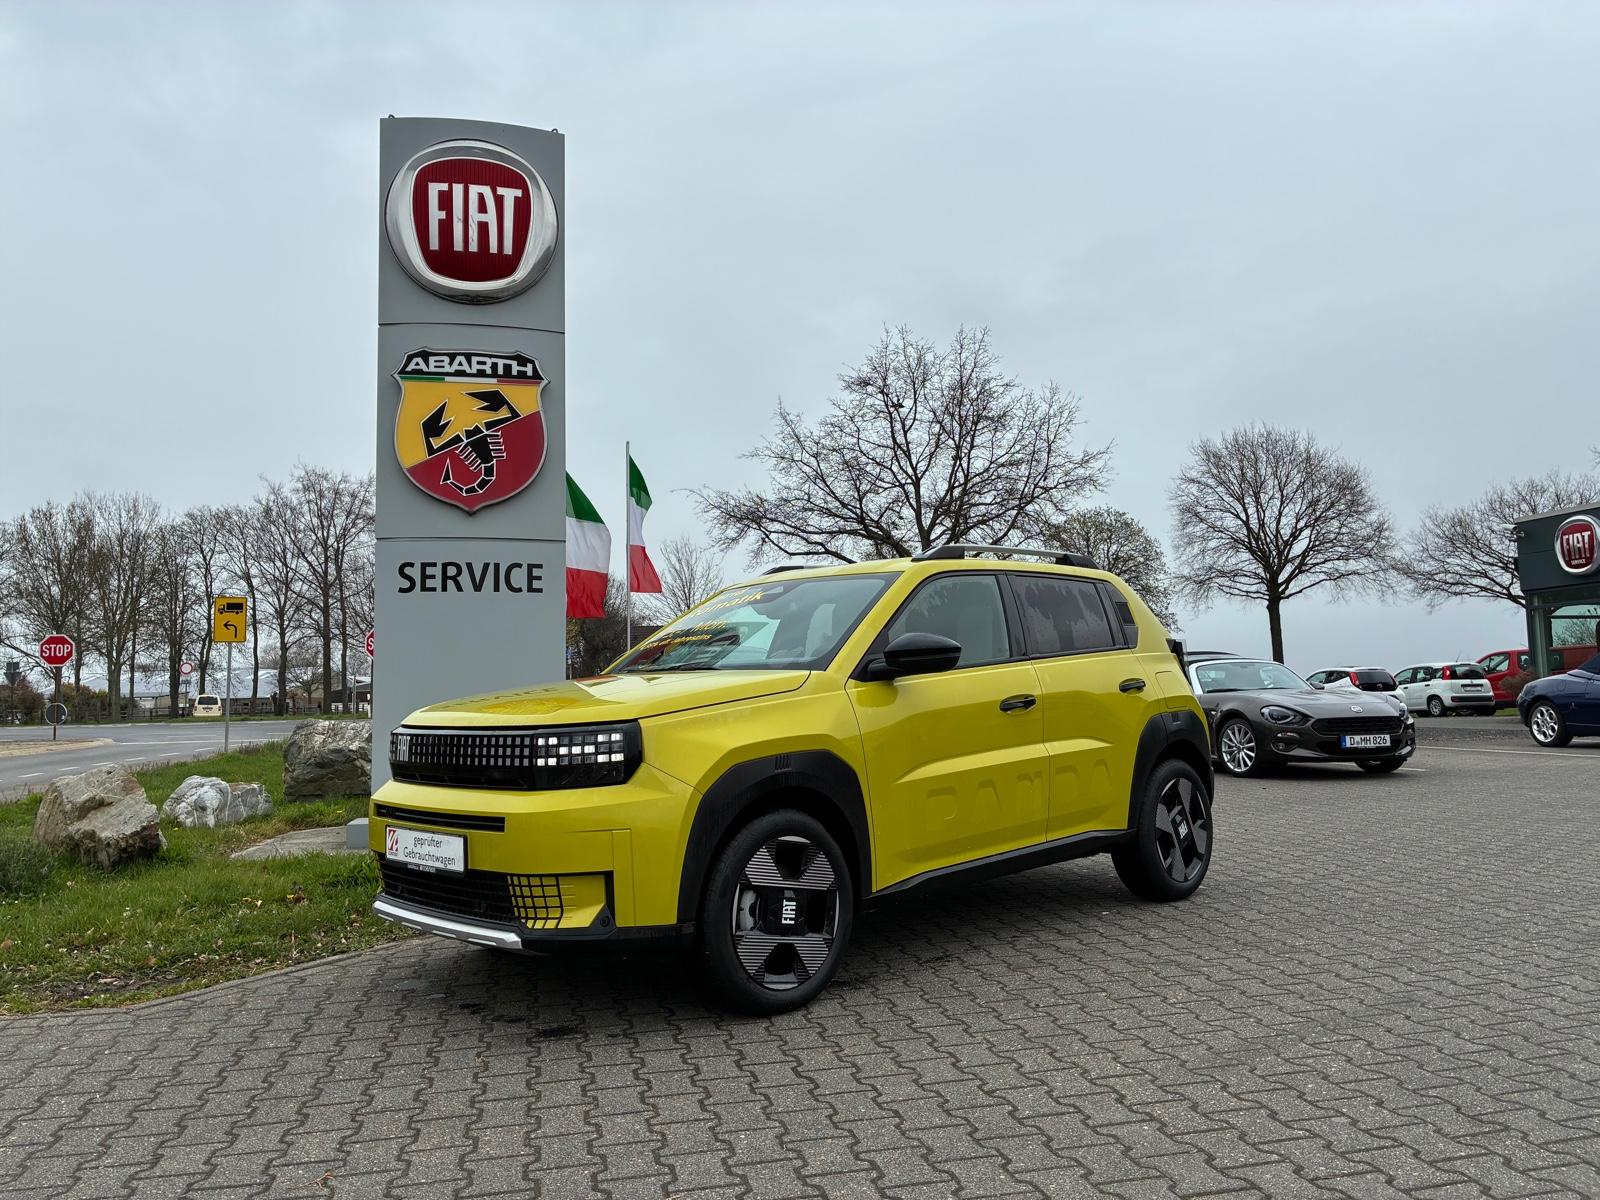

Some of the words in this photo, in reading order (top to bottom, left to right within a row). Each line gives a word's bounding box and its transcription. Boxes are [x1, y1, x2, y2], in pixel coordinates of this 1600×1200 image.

[428, 182, 522, 255] FIAT
[405, 355, 533, 377] ABARTH
[1563, 531, 1590, 560] FIAT
[398, 561, 544, 594] SERVICE
[42, 644, 71, 657] STOP
[397, 735, 410, 761] FIAT
[1350, 737, 1355, 745] D
[1360, 736, 1371, 745] MH
[1373, 736, 1387, 745] 826
[414, 836, 443, 849] geprüfter
[403, 846, 456, 867] Gebrauchtwagen
[782, 899, 797, 925] FIAT
